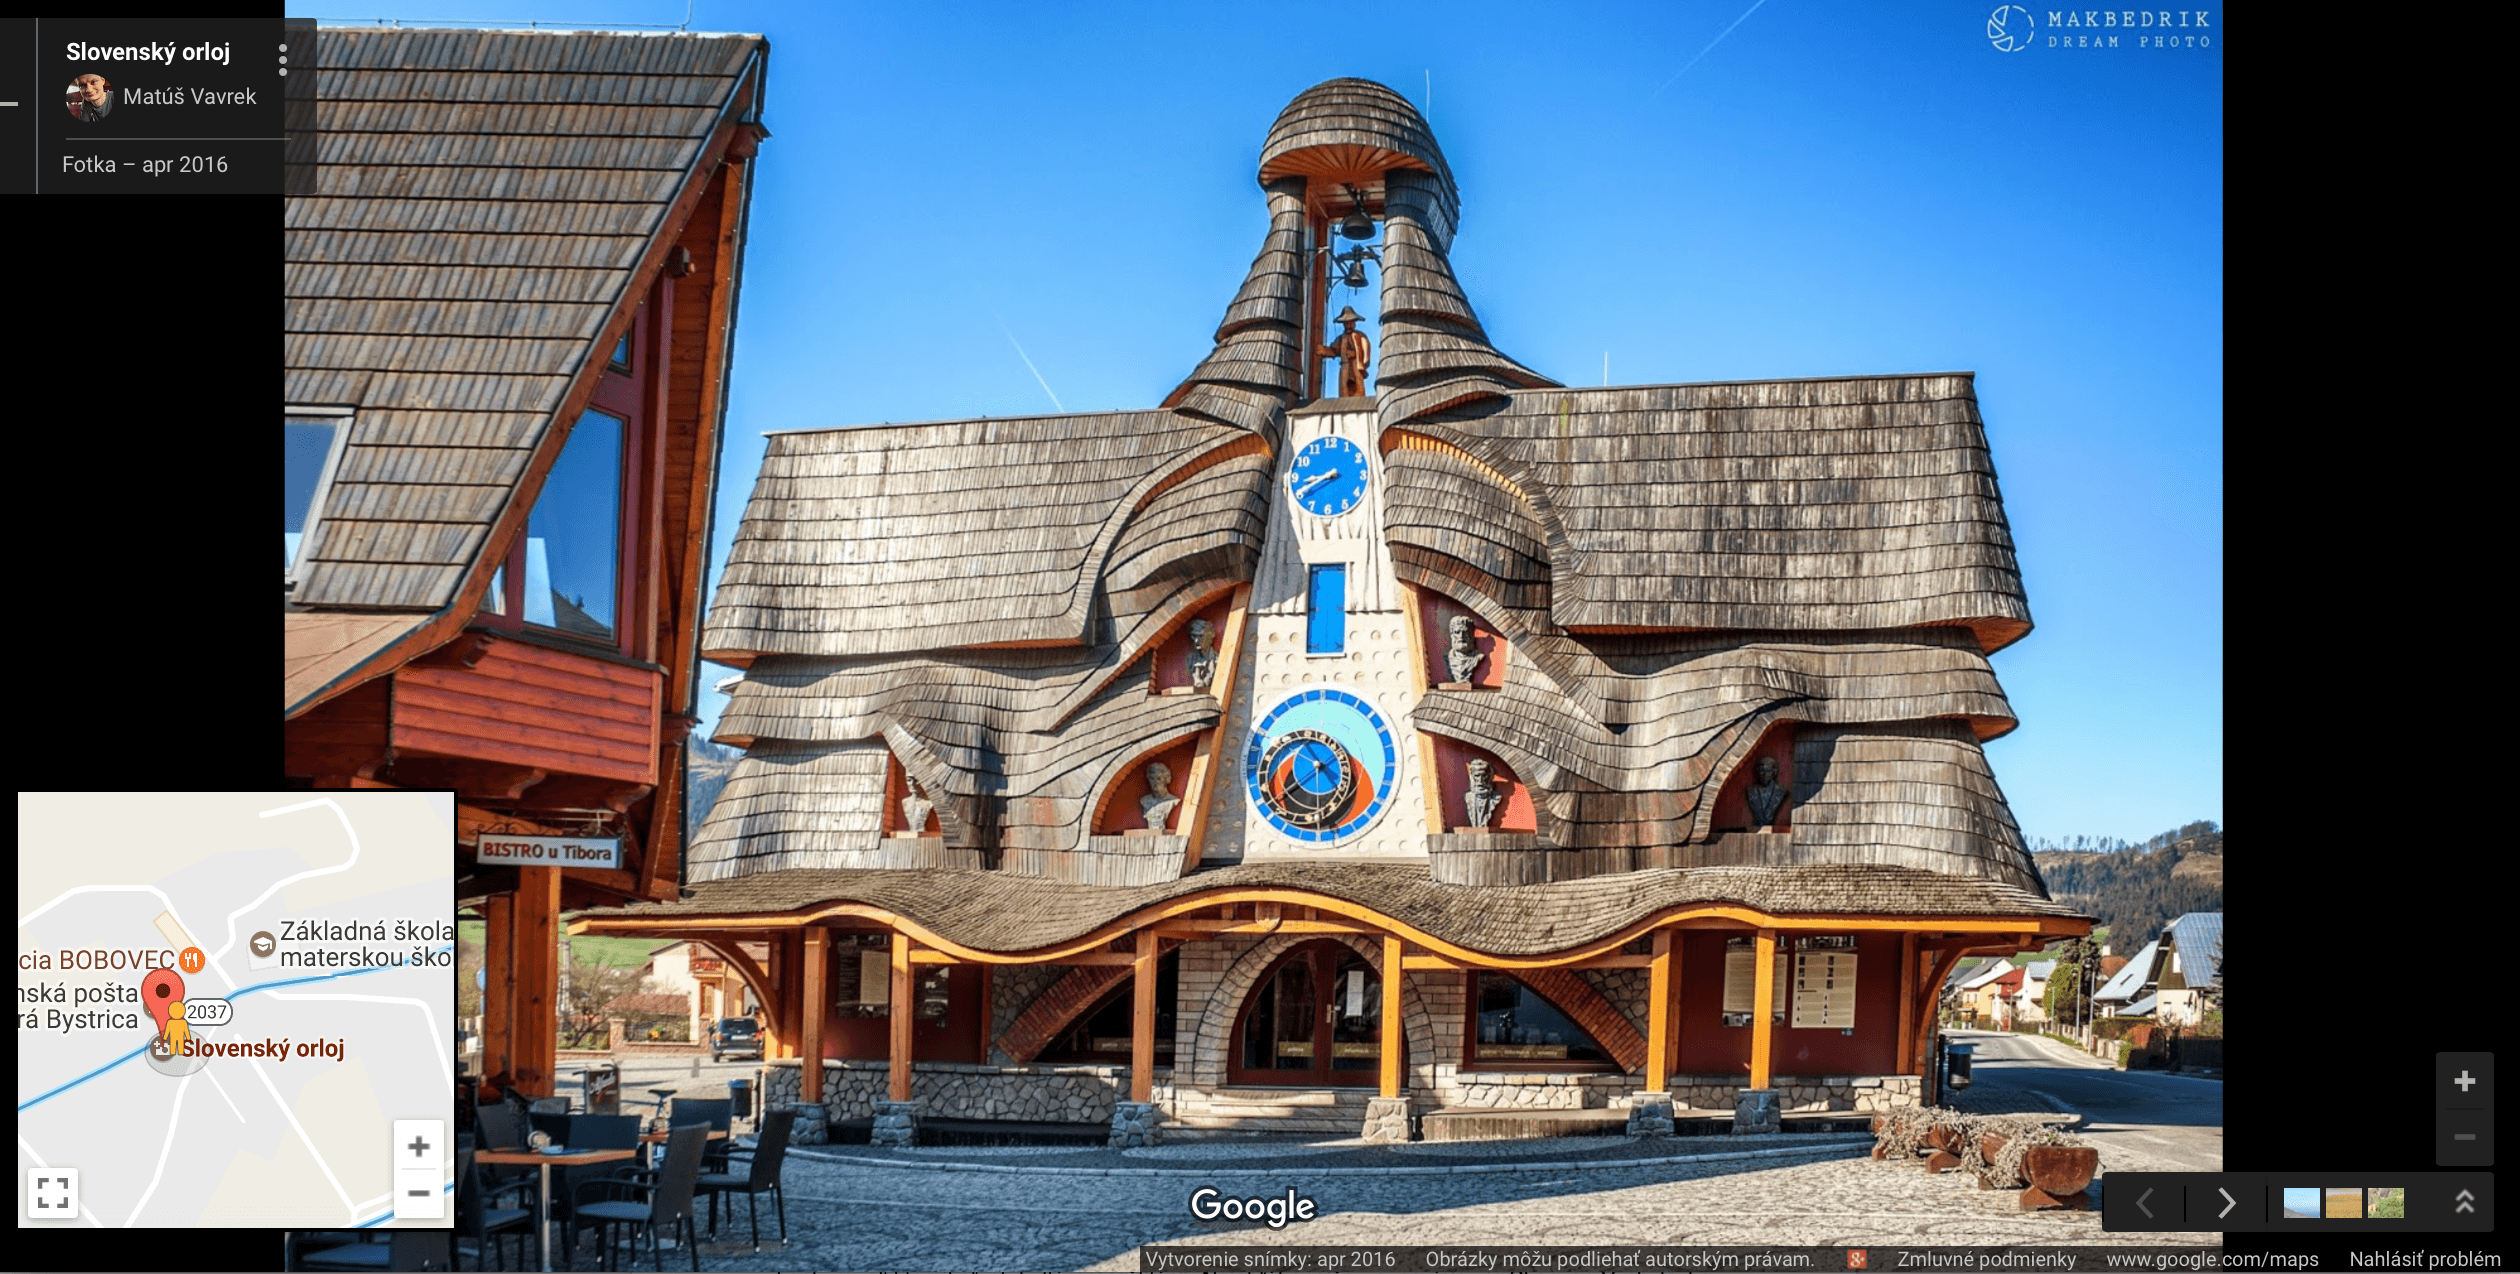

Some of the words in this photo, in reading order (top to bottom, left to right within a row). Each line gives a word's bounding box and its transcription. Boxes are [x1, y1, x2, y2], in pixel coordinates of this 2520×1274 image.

[1325, 438, 1338, 449] 12
[1344, 442, 1350, 453] 1
[1309, 444, 1321, 455] 11
[1297, 456, 1311, 467] 10
[1354, 452, 1363, 463] 2
[1291, 472, 1299, 483] 9
[1360, 470, 1367, 481] 3
[1353, 487, 1360, 498] 4
[1308, 501, 1316, 511] 7
[1324, 504, 1332, 515] 6
[483, 842, 544, 859] BISTRO
[548, 847, 558, 859] u
[562, 844, 612, 860] Tibora
